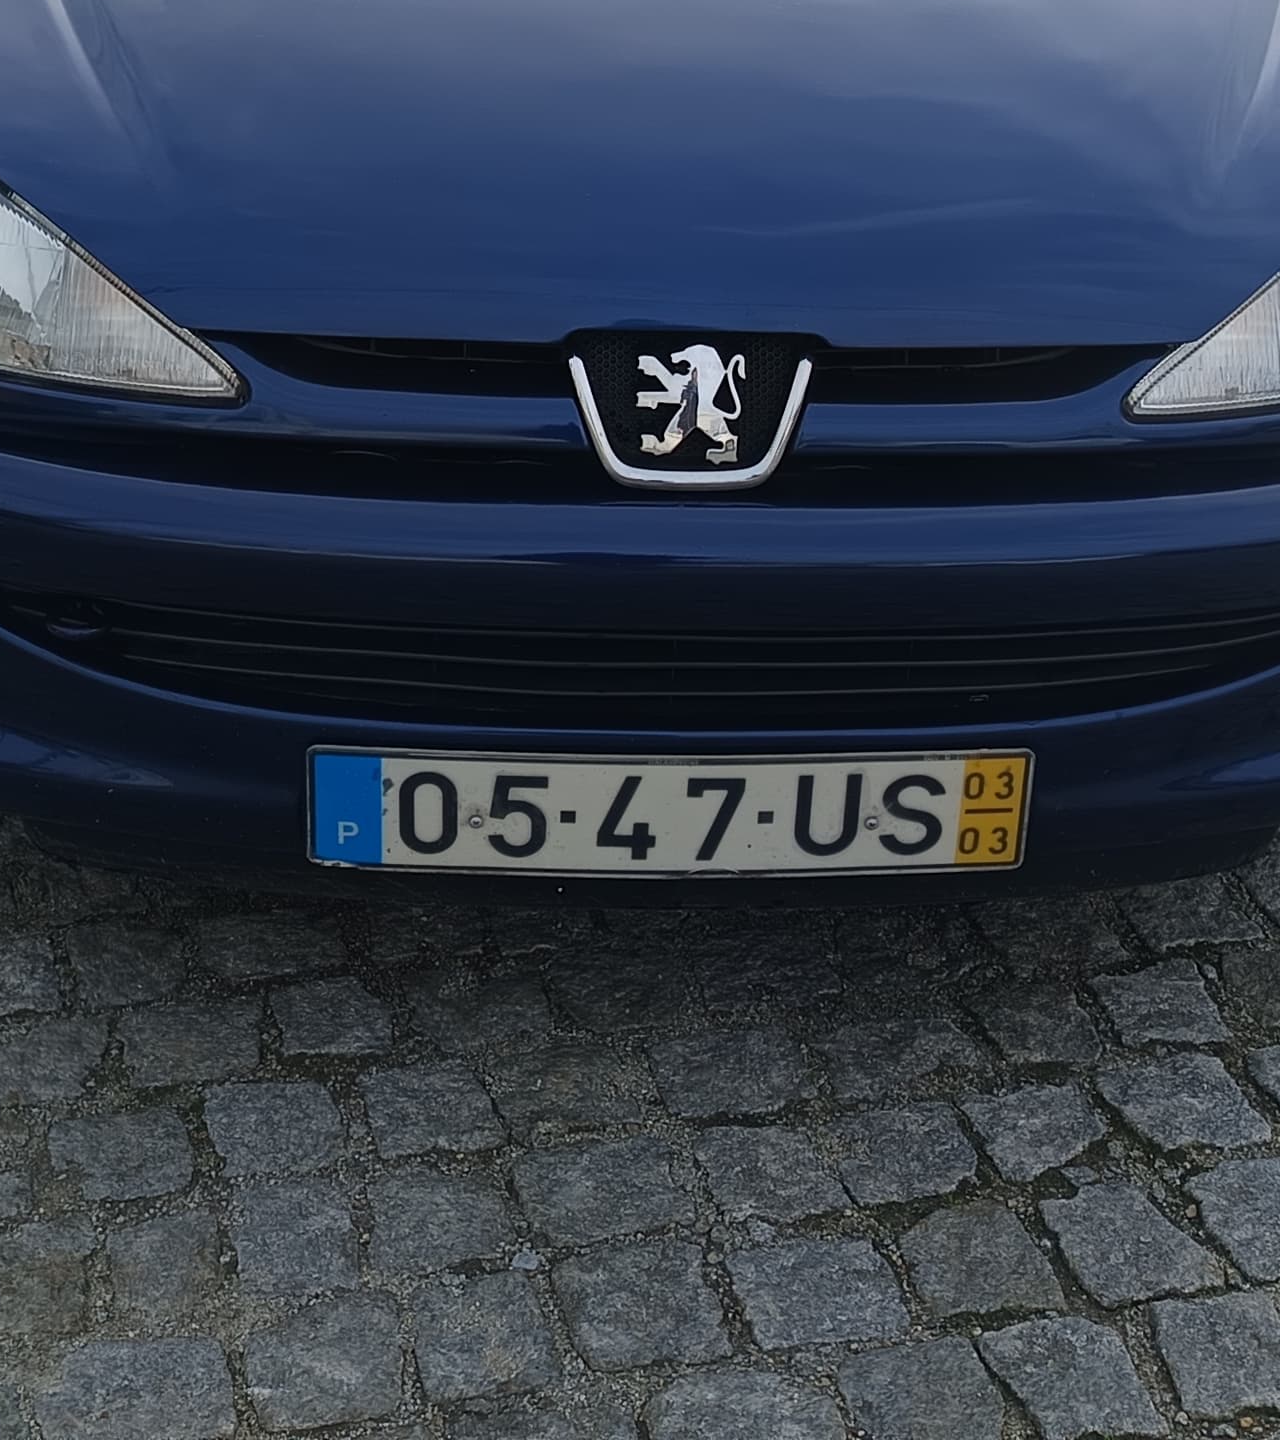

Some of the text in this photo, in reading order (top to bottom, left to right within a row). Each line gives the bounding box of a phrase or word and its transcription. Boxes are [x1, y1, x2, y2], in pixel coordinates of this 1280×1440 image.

[964, 769, 1015, 801] 03
[337, 821, 360, 845] P
[958, 827, 1009, 855] 03
